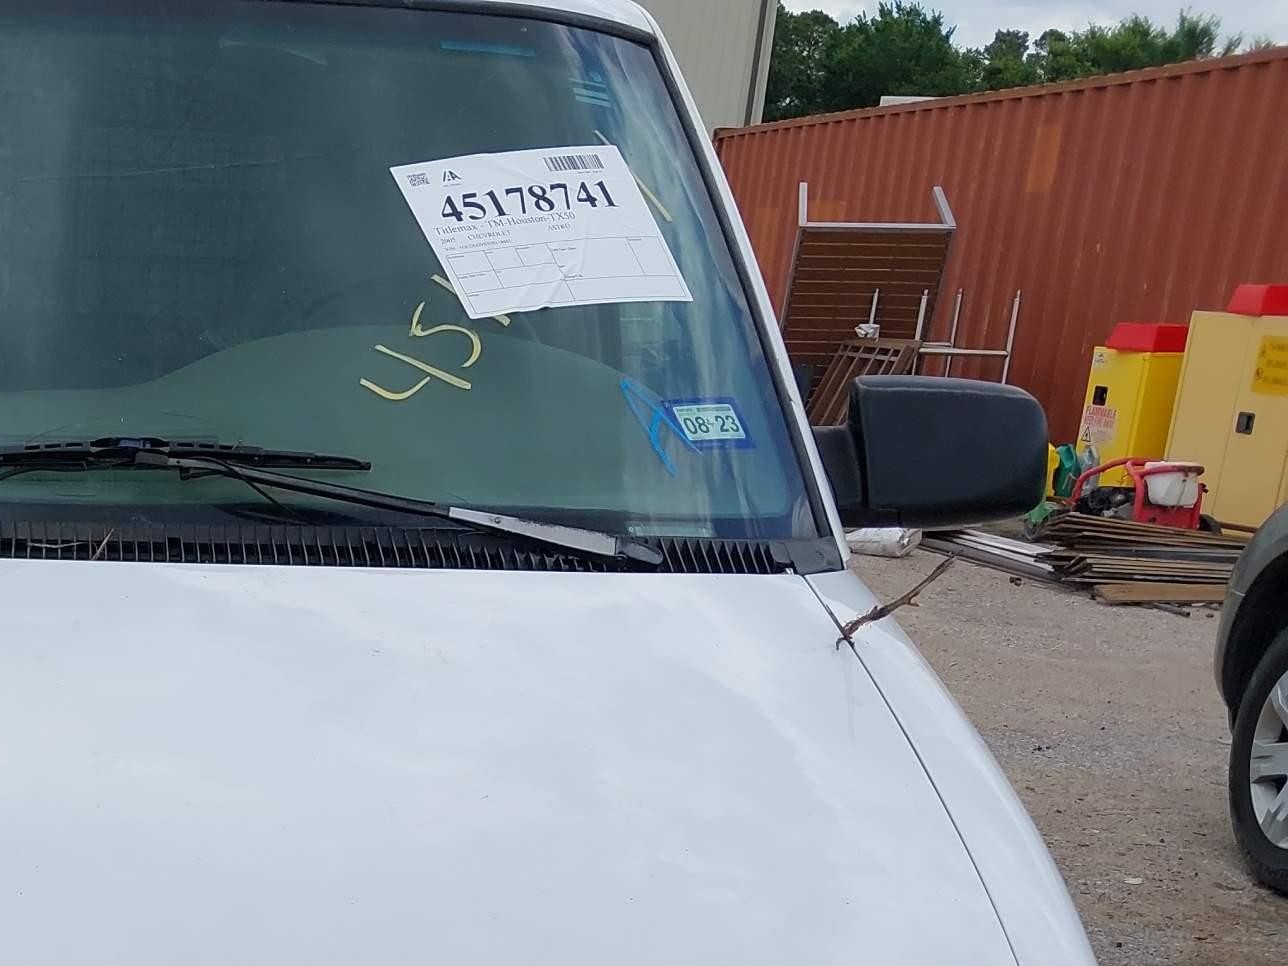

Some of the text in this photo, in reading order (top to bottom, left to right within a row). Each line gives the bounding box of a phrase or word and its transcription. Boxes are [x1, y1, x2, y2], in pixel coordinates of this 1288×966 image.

[441, 180, 621, 222] 45178741
[434, 224, 478, 236] Titlemax
[486, 211, 576, 229] TM-Houston-TX50
[683, 415, 740, 435] 08 23
